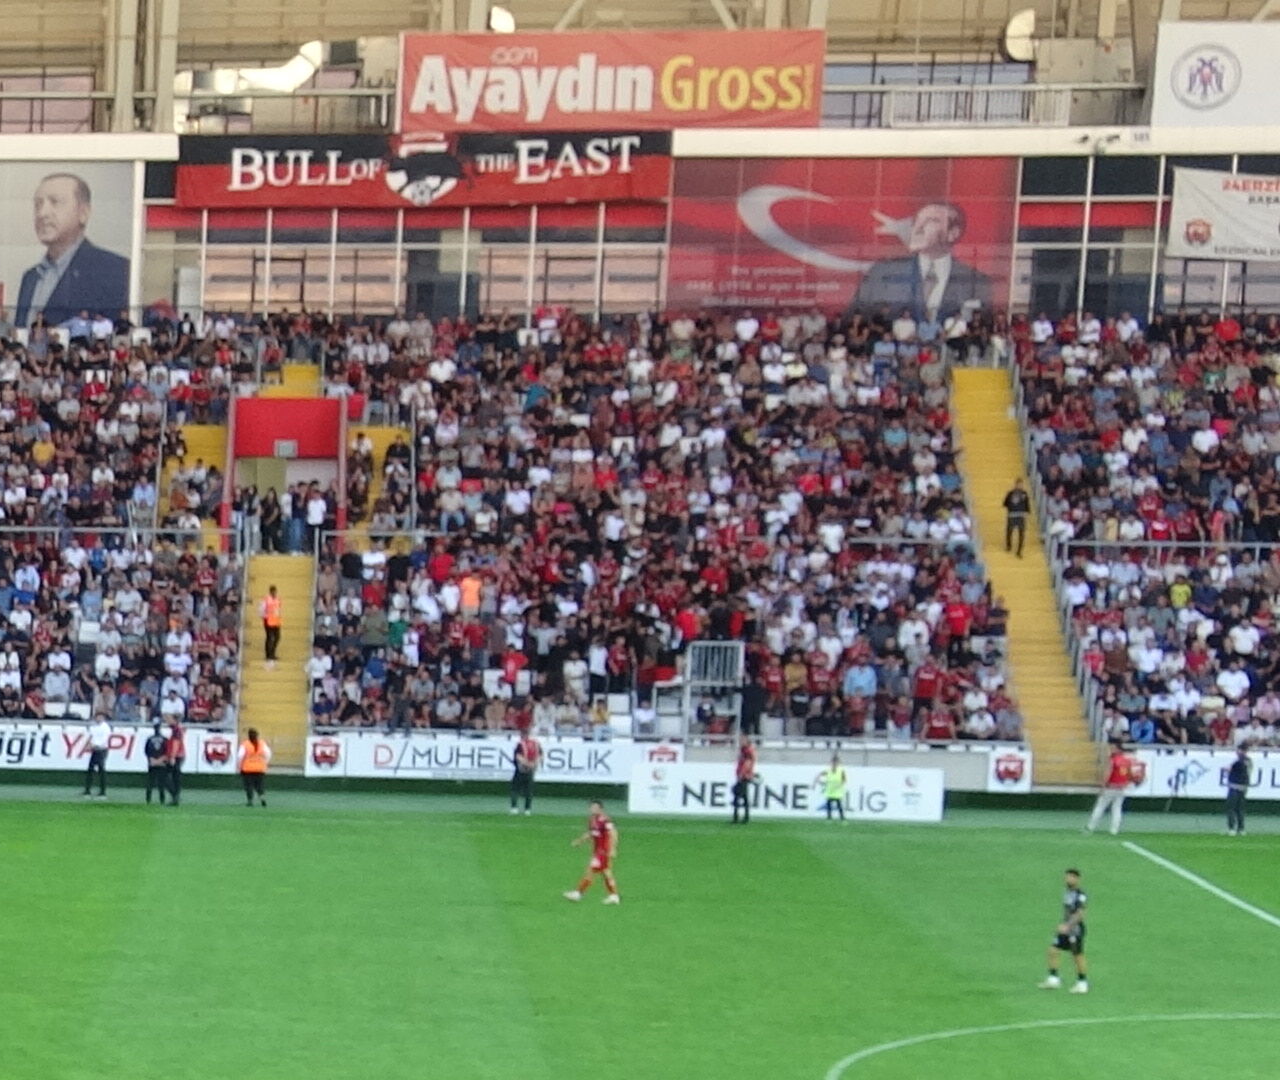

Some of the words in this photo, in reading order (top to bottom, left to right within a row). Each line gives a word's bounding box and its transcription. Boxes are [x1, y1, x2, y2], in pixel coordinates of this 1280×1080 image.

[408, 54, 654, 123] Ayaydın
[661, 54, 803, 111] Gross
[227, 148, 352, 191] BULL
[351, 158, 383, 180] OF
[476, 153, 515, 173] THE
[515, 136, 640, 184] EAST
